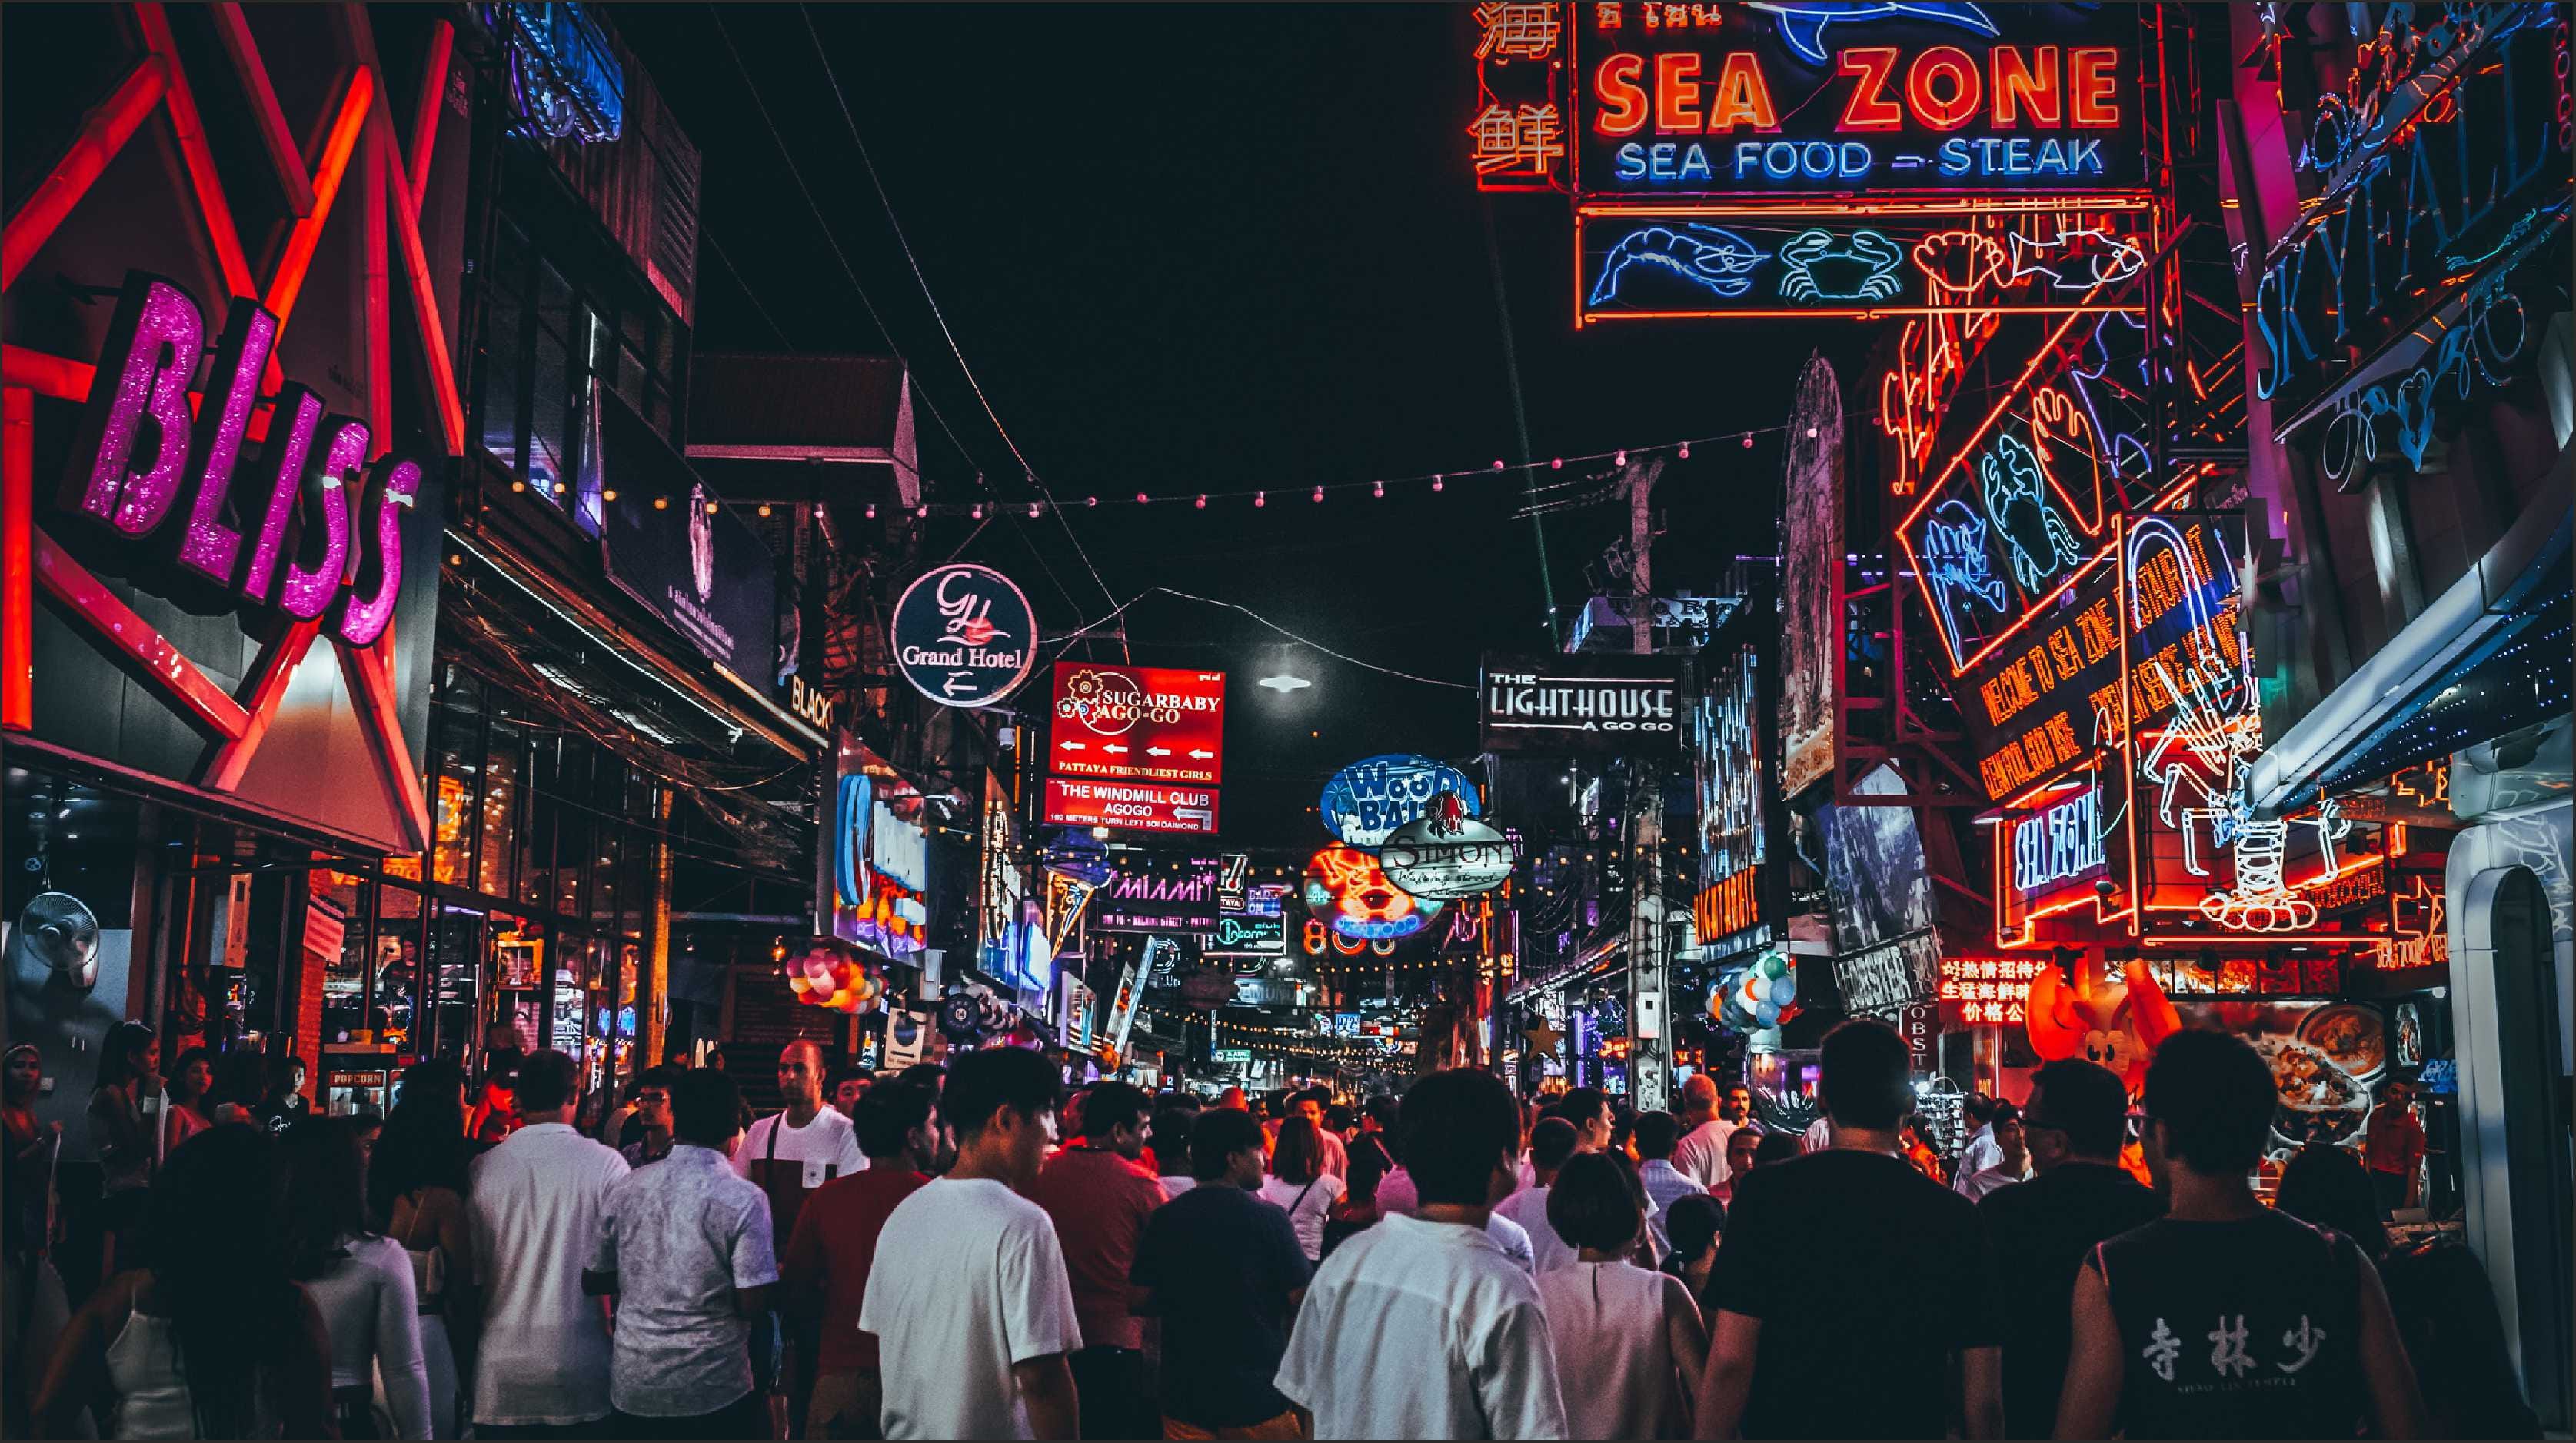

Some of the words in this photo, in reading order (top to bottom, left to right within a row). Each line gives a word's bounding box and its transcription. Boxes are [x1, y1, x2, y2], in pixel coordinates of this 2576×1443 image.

[1593, 51, 1782, 135] SEA
[1835, 45, 2121, 133] ZONE
[1614, 140, 1711, 182] SEA
[1735, 140, 1872, 178] FOOD
[1937, 138, 2104, 177] STEAK
[81, 280, 422, 648] BLISS
[903, 646, 964, 667] Grand
[968, 649, 1022, 669] Hotel
[1980, 657, 2040, 726] WELCOME
[2028, 645, 2055, 693] TO
[2048, 625, 2085, 680] SEA
[2075, 599, 2122, 664] ZONE
[1489, 672, 1537, 685] THE
[792, 675, 832, 731] BLACK
[1103, 689, 1220, 712] SUGARBABY
[1489, 688, 1674, 718] LIGHTHOUSE
[1097, 705, 1180, 724] AGO-GO
[1582, 721, 1599, 731] A
[1602, 721, 1636, 731] GO
[1640, 722, 1674, 732] GO
[1058, 761, 1107, 774] PATTAYA
[1110, 766, 1179, 779] FRIENDLIEST
[1180, 771, 1213, 781] GIRLS
[1061, 783, 1090, 798] THE
[1093, 786, 1167, 804] WINDMILL
[1170, 792, 1210, 806] CLUB
[1066, 815, 1098, 824] METERS
[1100, 817, 1123, 825] TURN
[1103, 802, 1153, 817] AGOGO
[1393, 835, 1503, 870] SIMON
[2015, 816, 2050, 891] SEA
[334, 1074, 381, 1084] POPCORN
